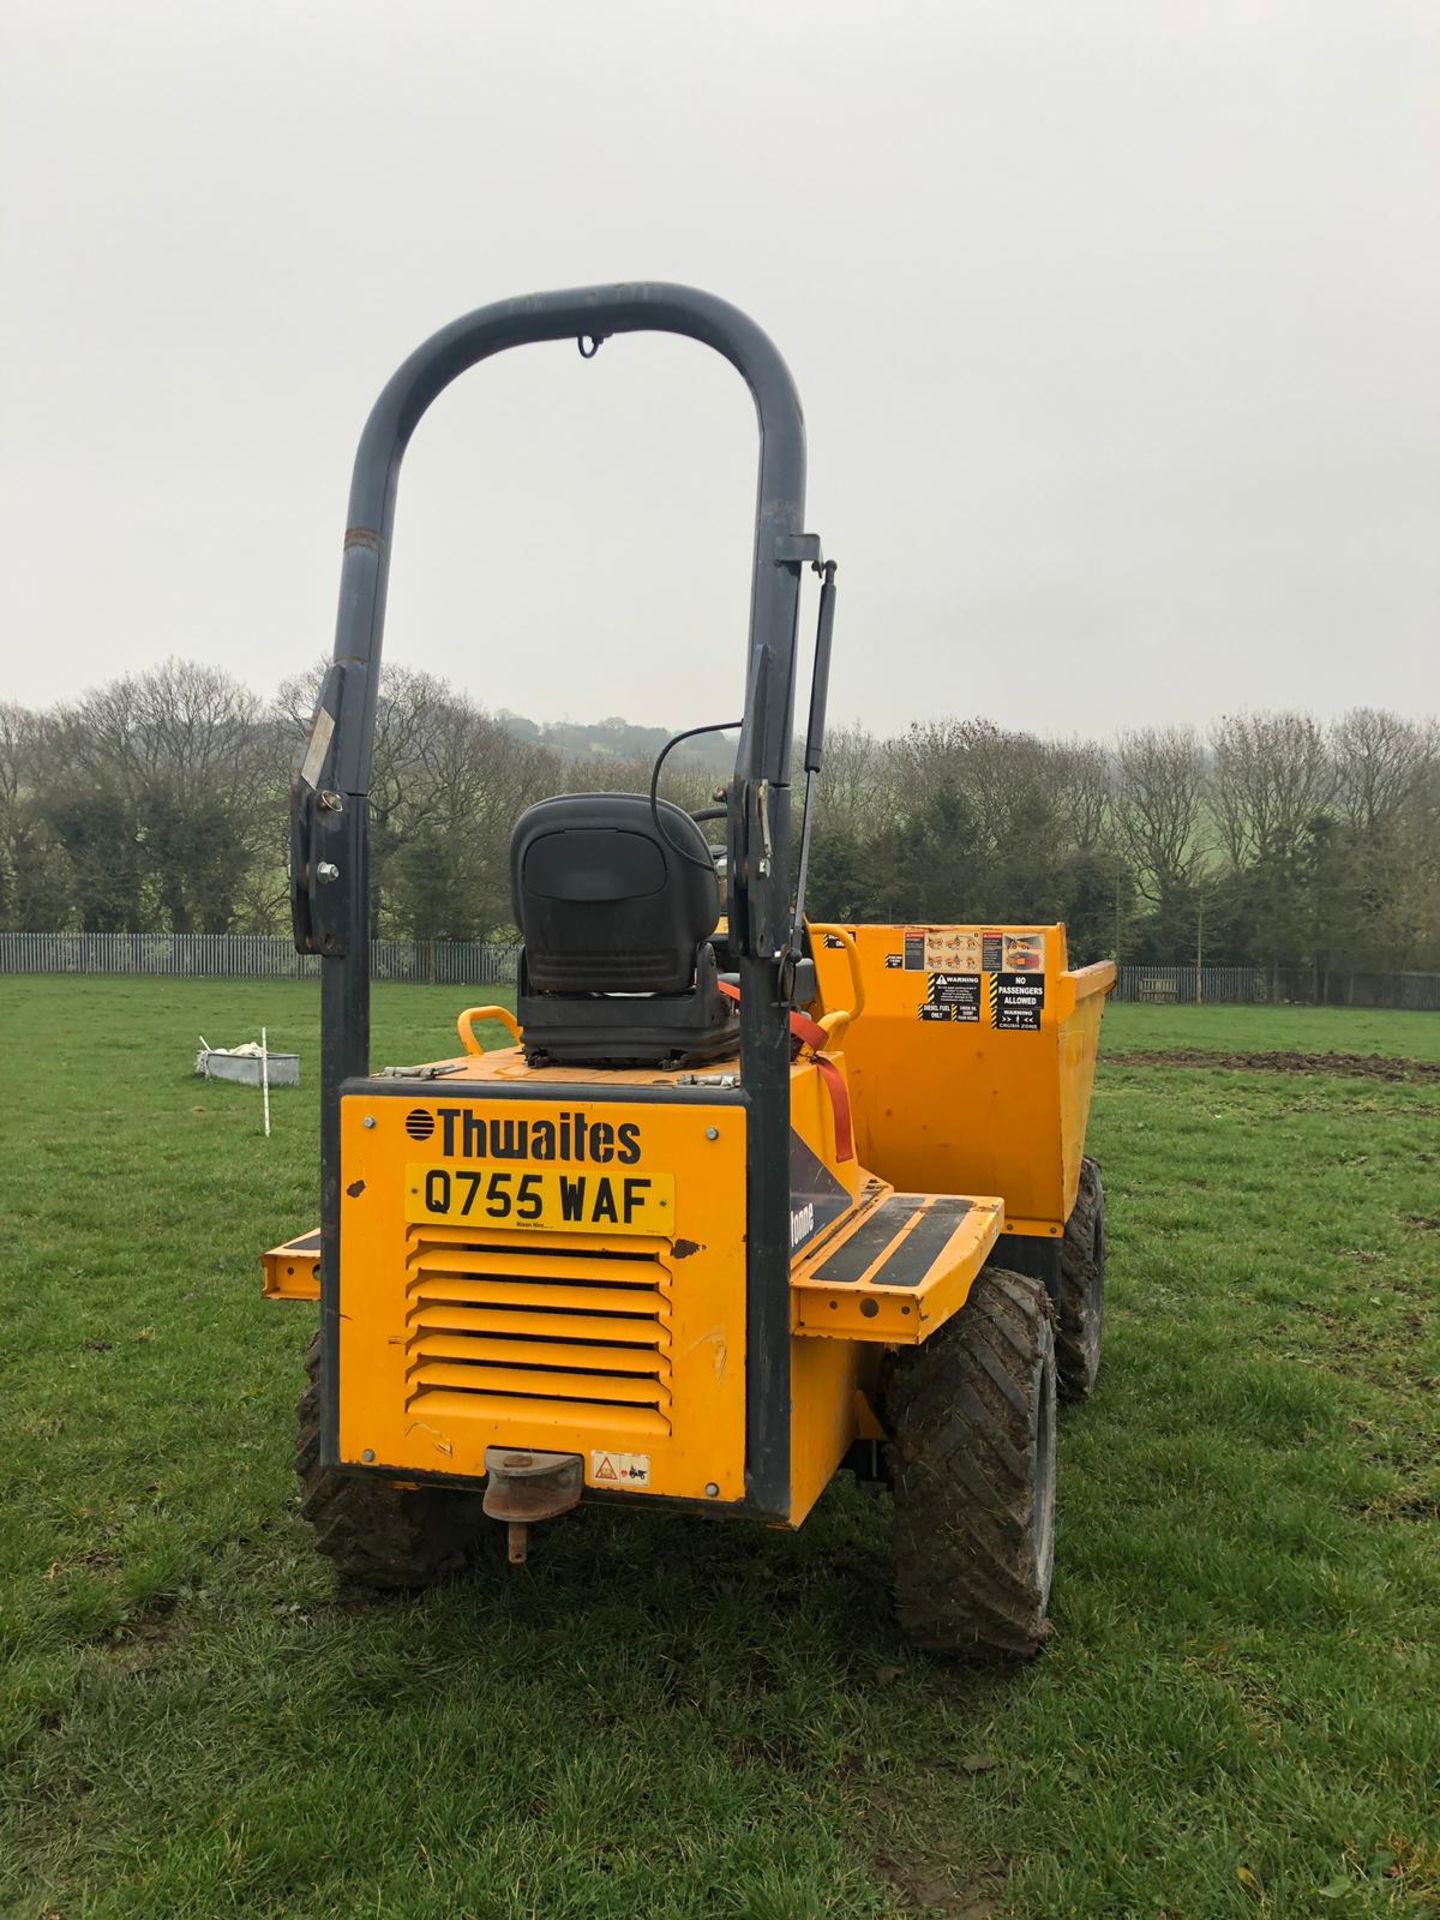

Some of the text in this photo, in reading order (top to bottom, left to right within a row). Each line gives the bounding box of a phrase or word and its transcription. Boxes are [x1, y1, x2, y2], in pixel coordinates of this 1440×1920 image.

[998, 986, 1043, 995] PASSENGERS
[1004, 997, 1037, 1005] ALLOWED
[437, 1108, 641, 1165] Thwaites
[425, 1169, 652, 1224] Q755 WAF
